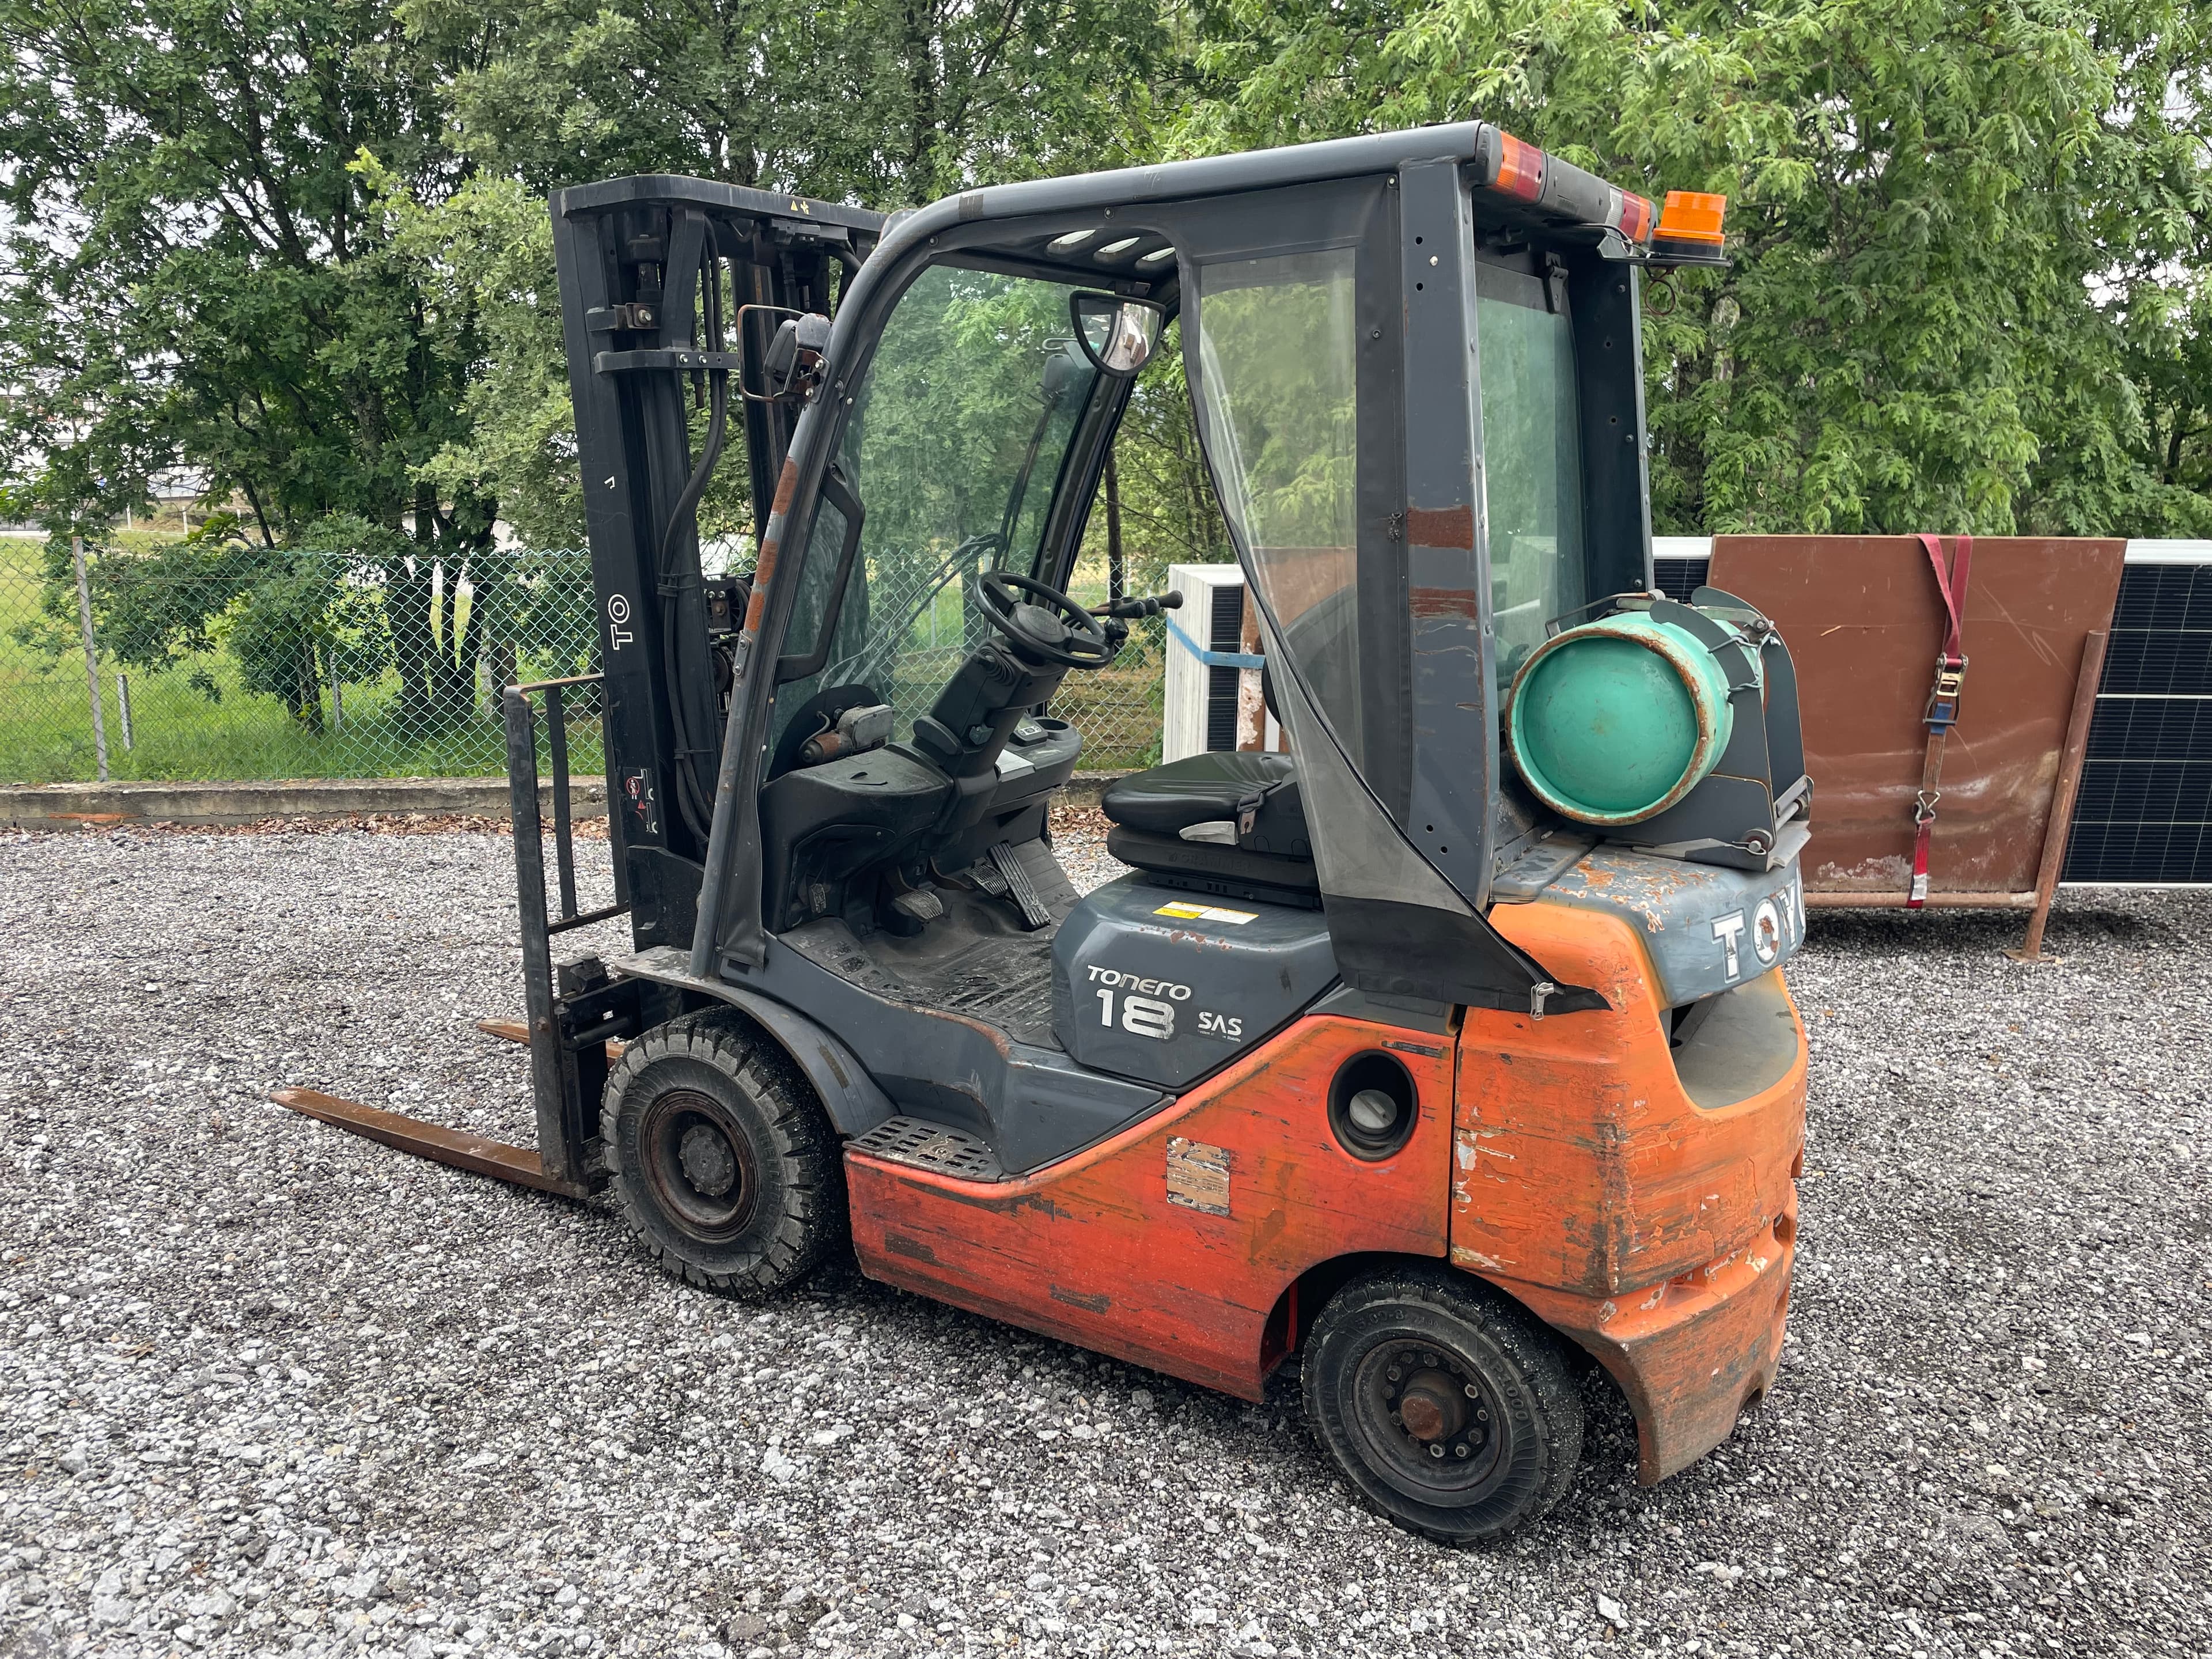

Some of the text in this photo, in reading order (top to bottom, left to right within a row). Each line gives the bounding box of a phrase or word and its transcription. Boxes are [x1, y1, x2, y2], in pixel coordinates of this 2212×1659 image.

[1087, 965, 1191, 1000] TONERO
[1096, 988, 1175, 1039] 18
[1198, 1012, 1241, 1036] SAS
